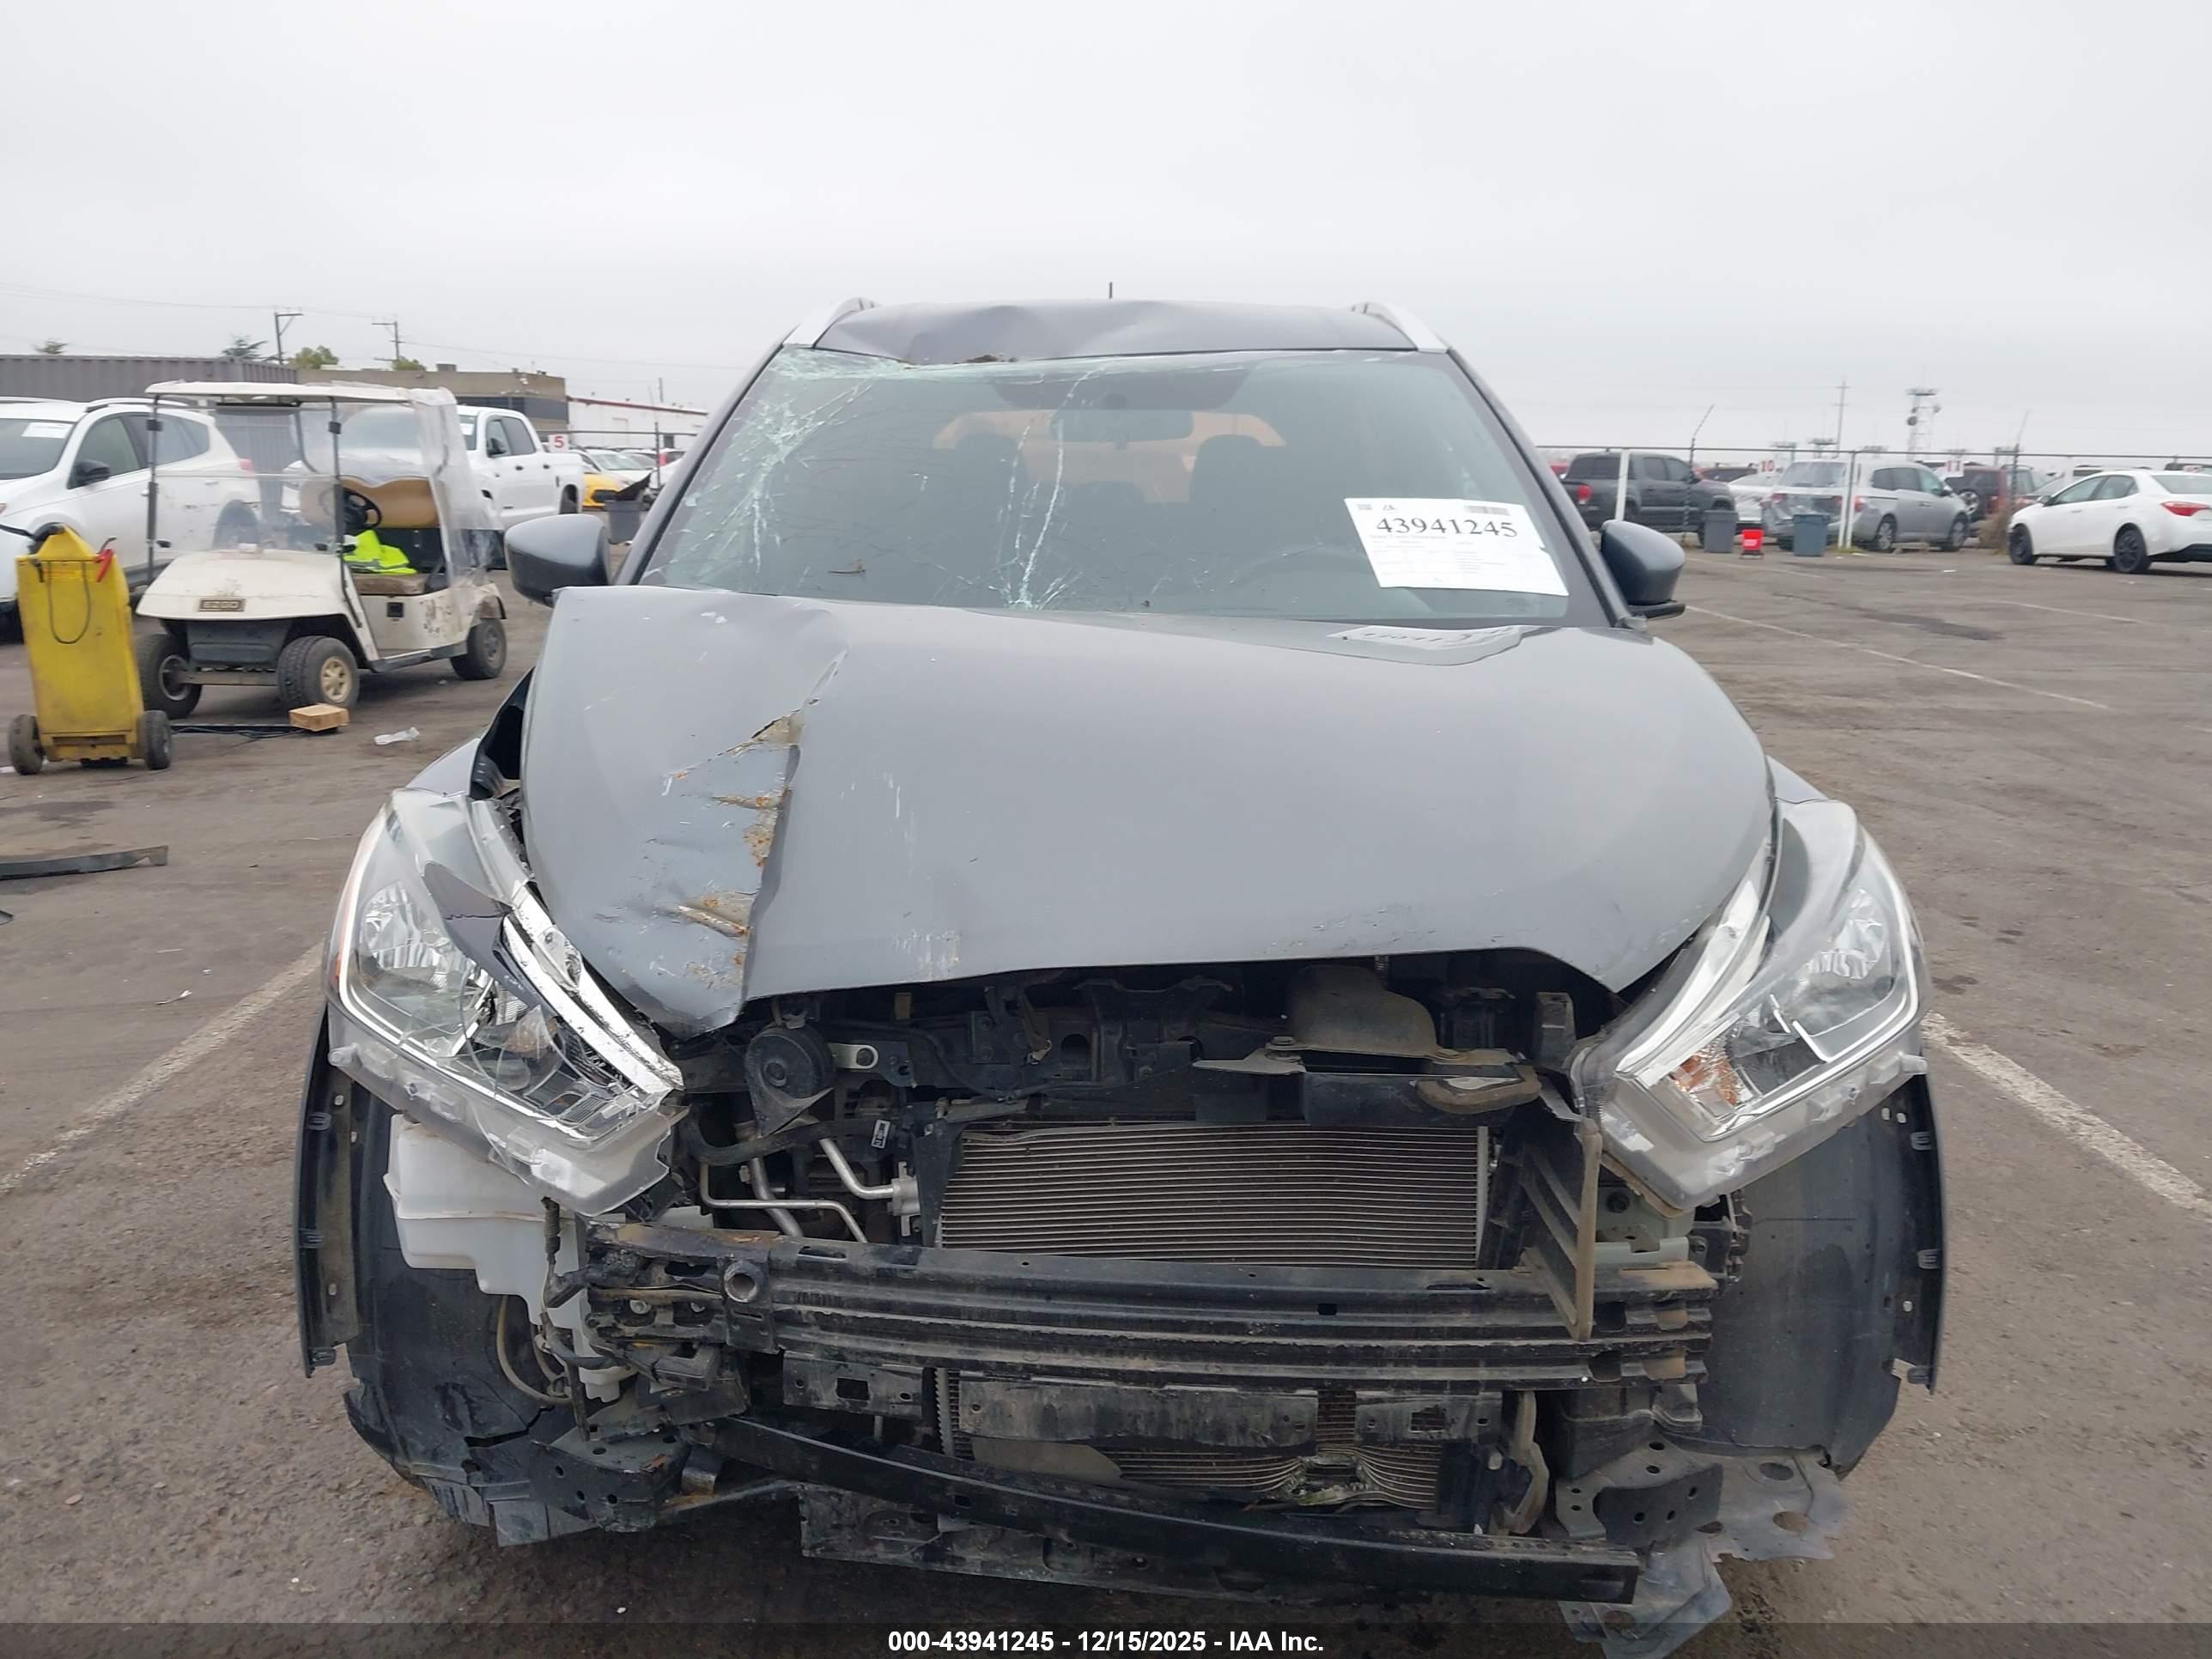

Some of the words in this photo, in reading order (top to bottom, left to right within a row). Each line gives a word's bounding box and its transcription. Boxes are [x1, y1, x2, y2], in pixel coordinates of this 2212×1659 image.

[554, 435, 564, 448] 5
[1761, 459, 1775, 472] 10
[1376, 517, 1518, 538] 43941245
